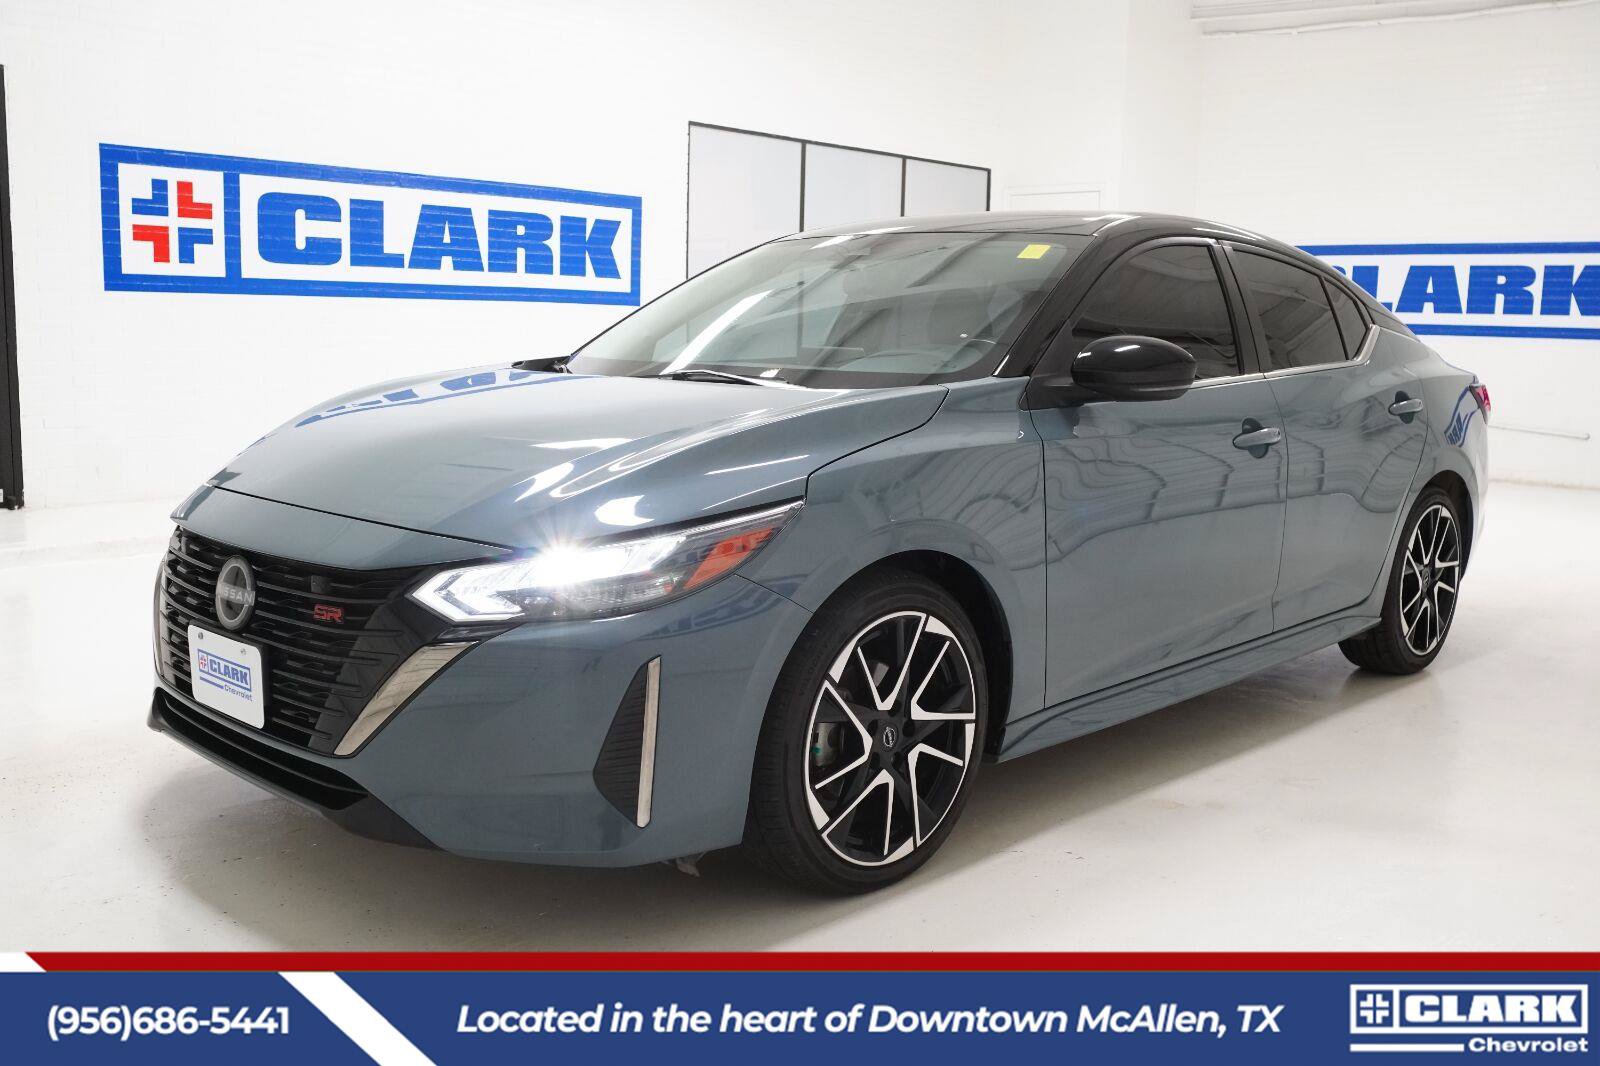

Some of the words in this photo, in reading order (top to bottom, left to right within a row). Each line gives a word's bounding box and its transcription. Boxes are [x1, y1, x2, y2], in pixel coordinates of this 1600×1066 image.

[257, 191, 621, 279] CLARK
[1331, 264, 1600, 316] LARK
[313, 603, 344, 624] SR
[209, 658, 249, 685] CLARK
[224, 684, 253, 702] Chevrolet
